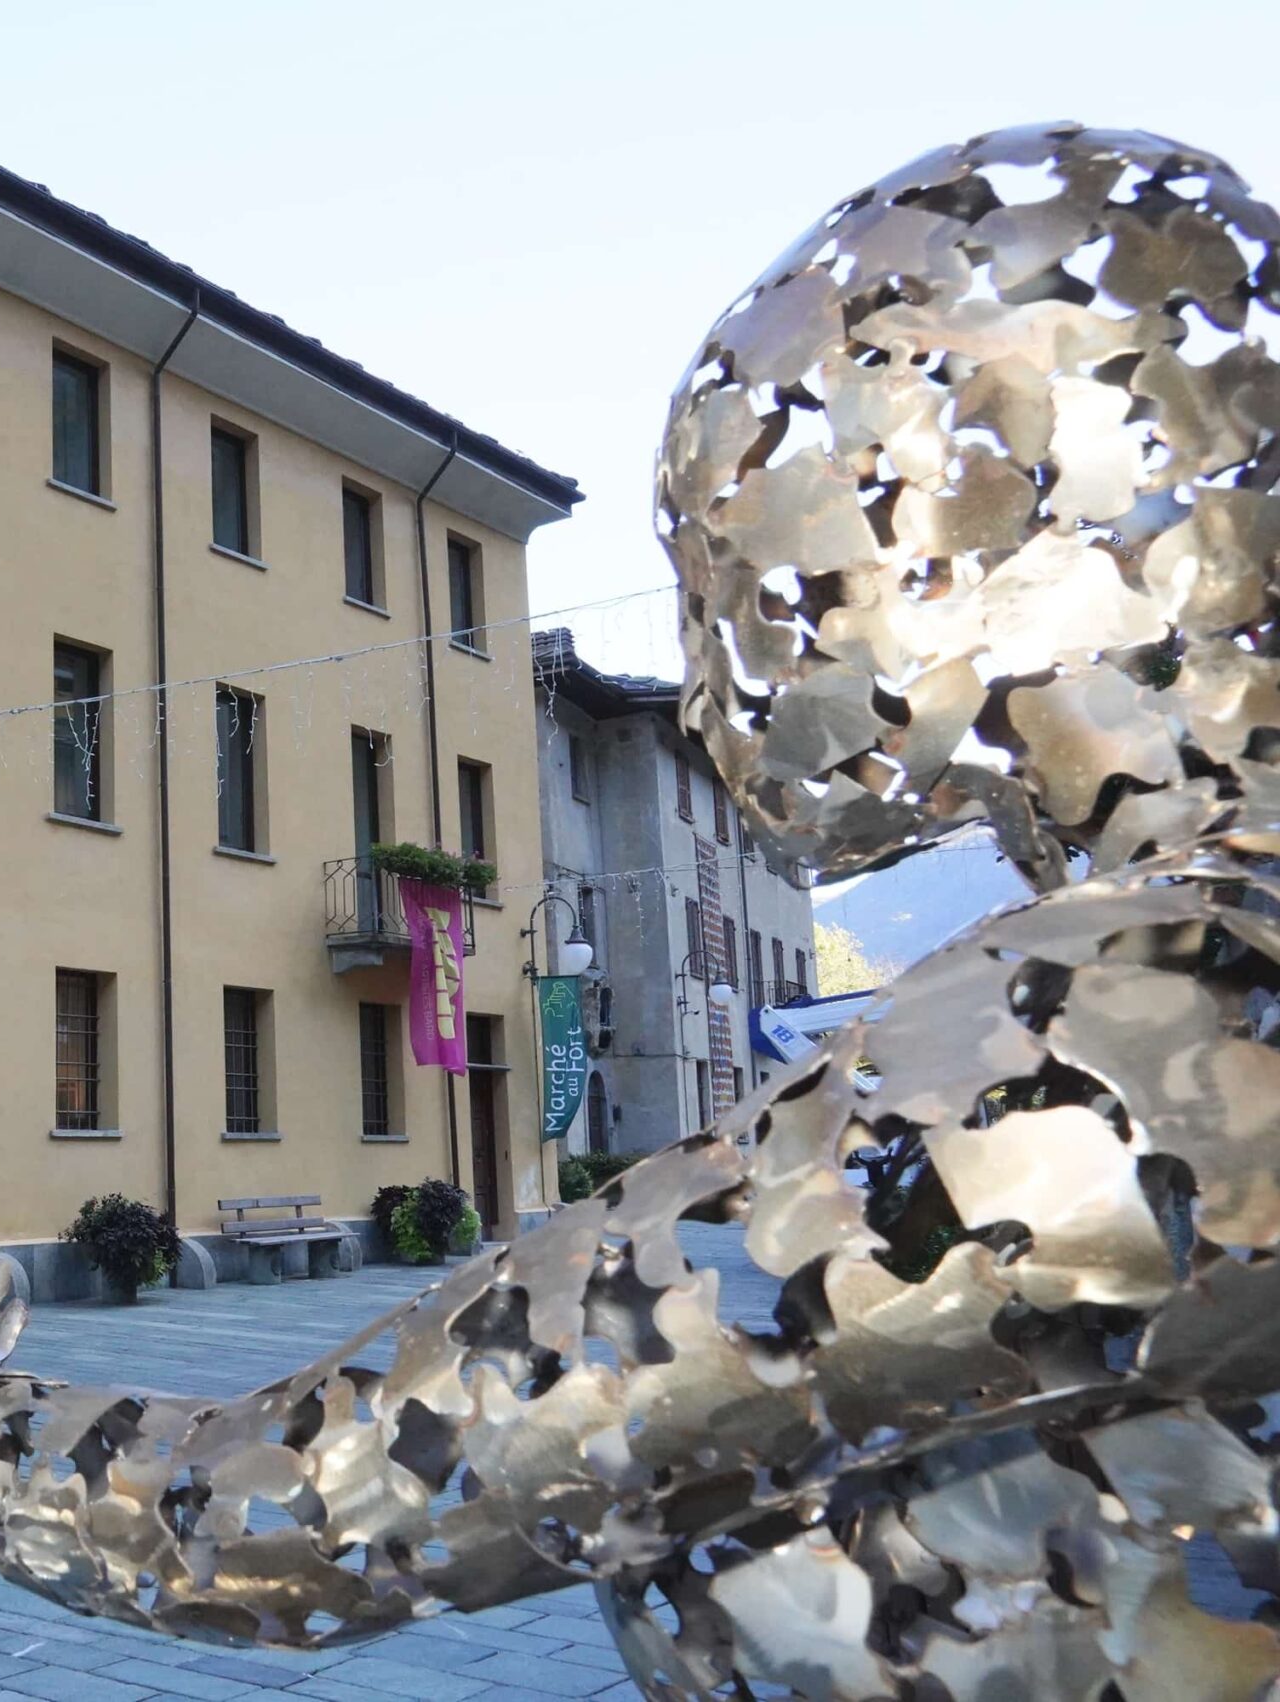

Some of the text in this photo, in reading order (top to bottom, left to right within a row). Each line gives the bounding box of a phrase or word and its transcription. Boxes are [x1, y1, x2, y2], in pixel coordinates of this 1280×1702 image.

[566, 1026, 585, 1097] au Fort
[772, 1025, 795, 1043] 18
[545, 1043, 567, 1132] Marché
